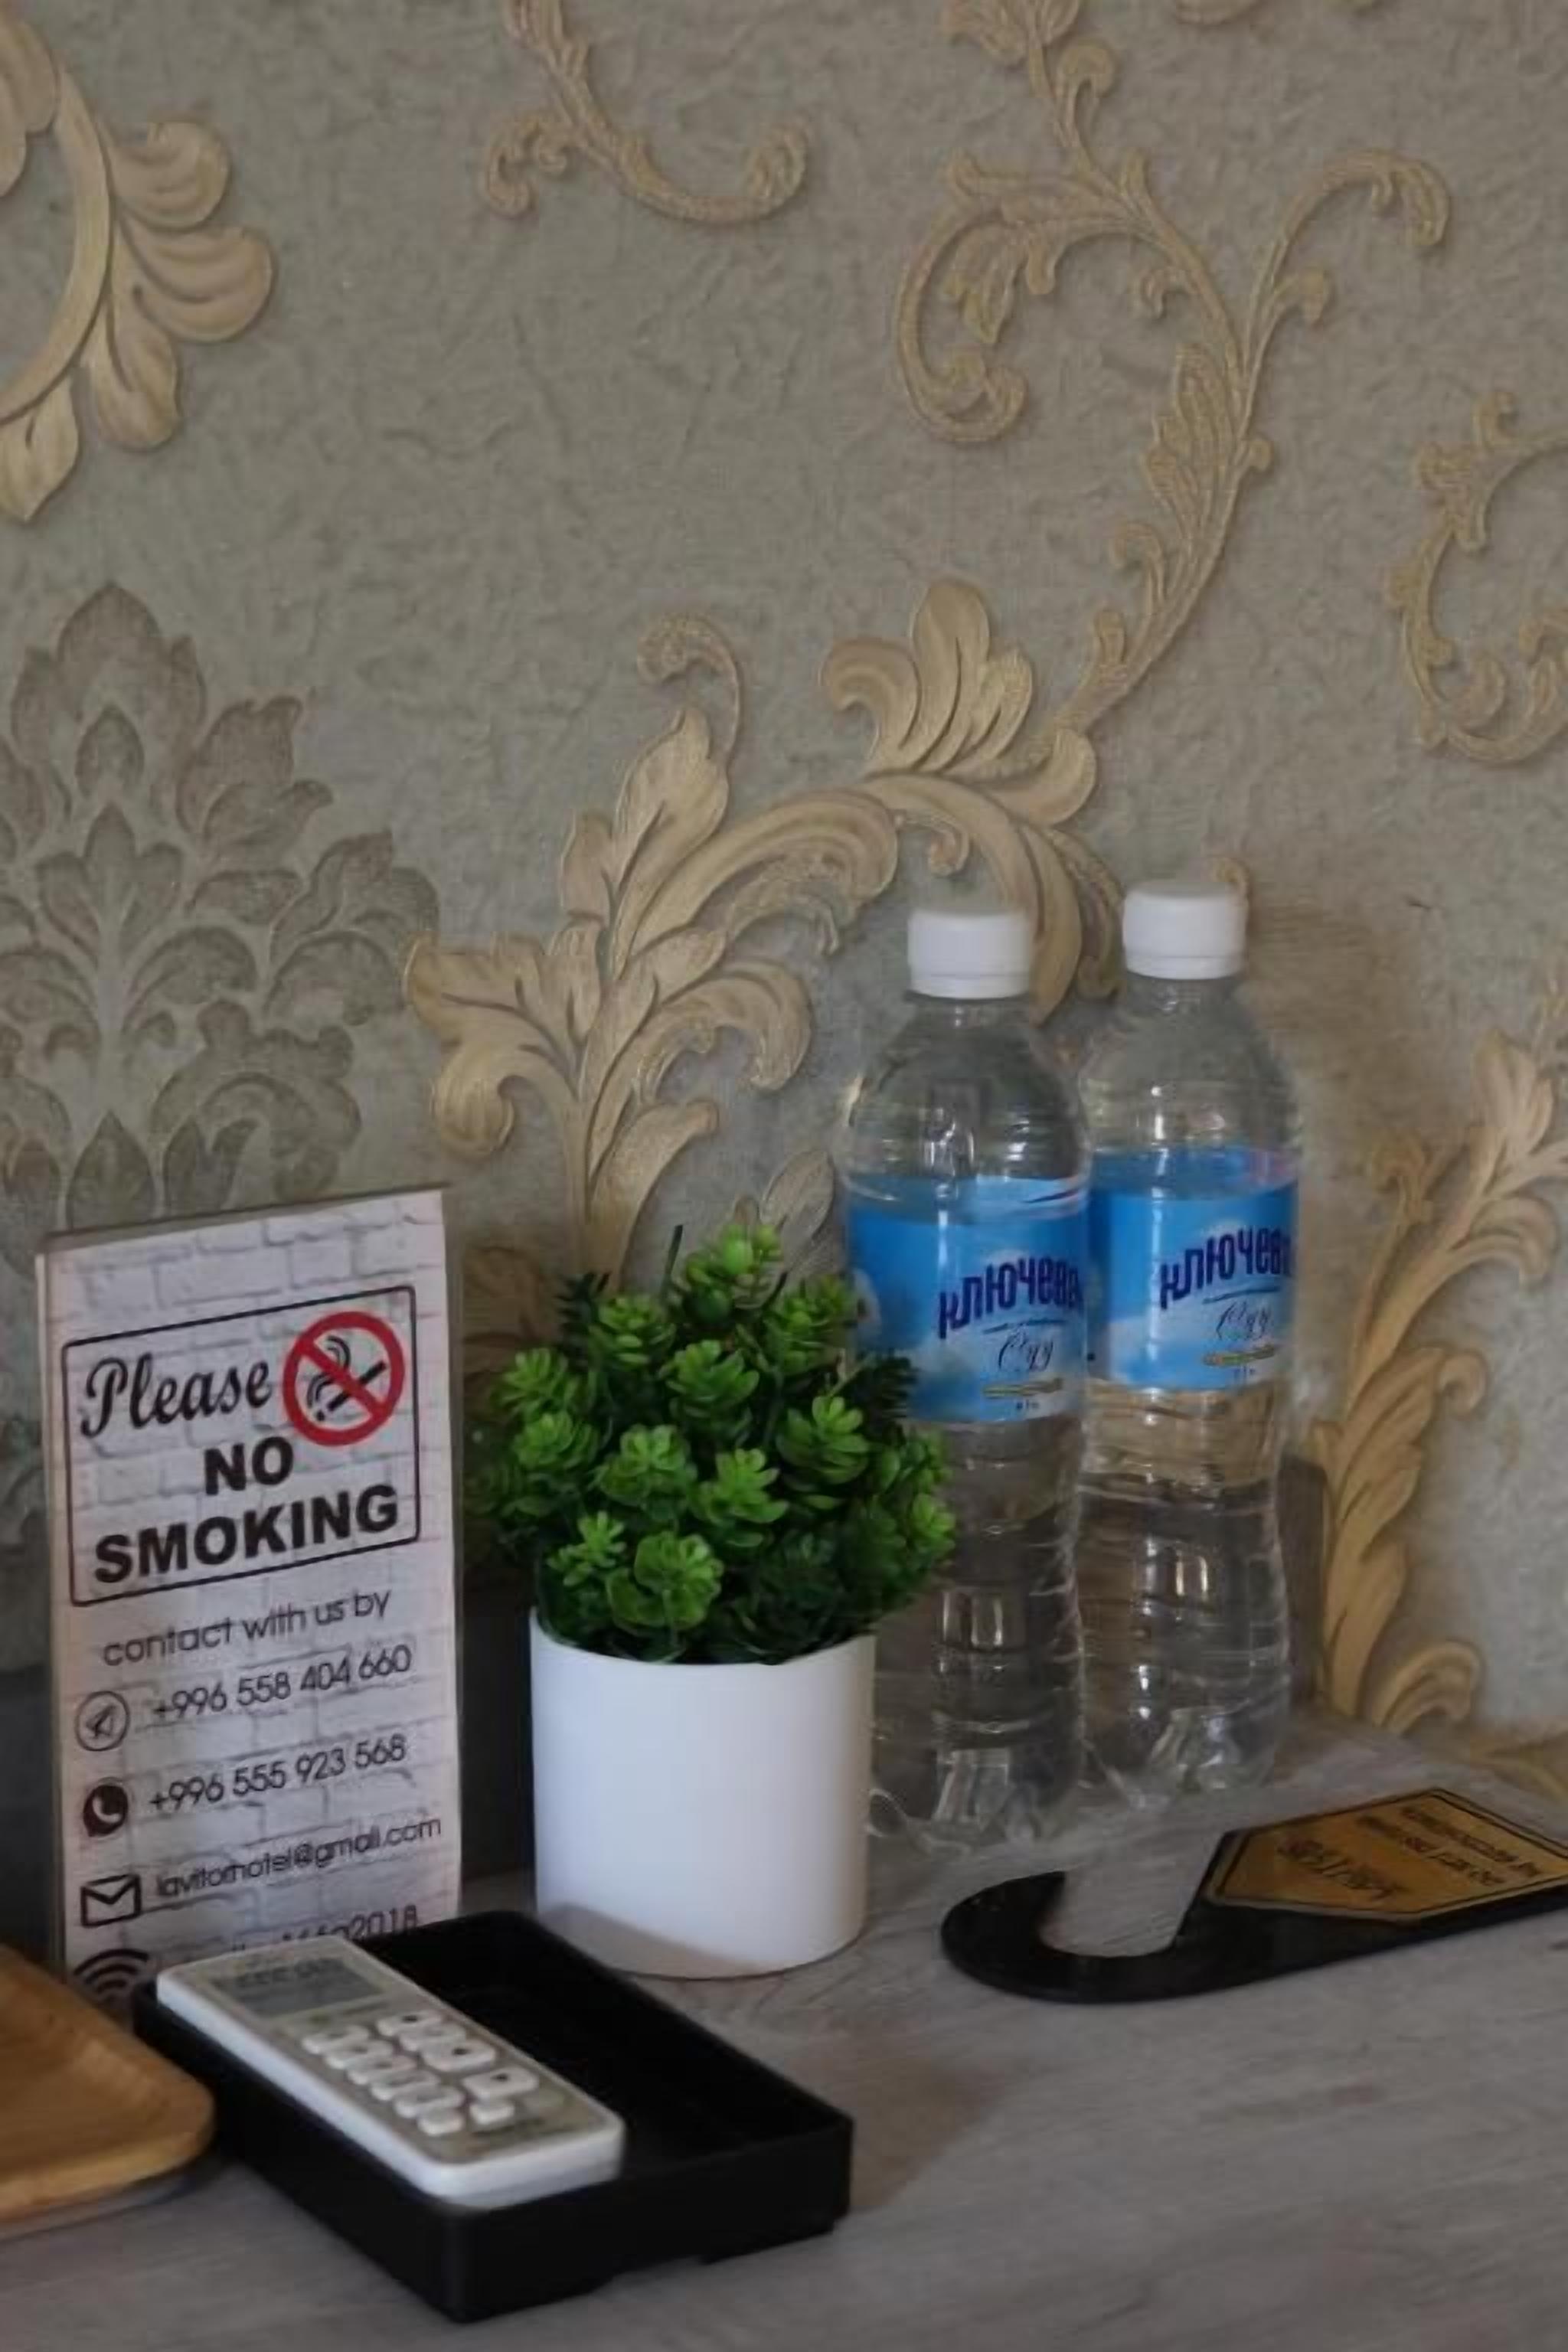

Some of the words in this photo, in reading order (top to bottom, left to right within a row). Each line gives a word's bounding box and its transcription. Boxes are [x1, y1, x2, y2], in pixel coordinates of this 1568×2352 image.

[81, 1353, 271, 1437] Please
[204, 1436, 295, 1495] NO
[93, 1484, 398, 1583] SMOKING
[102, 1617, 233, 1667] contact
[242, 1602, 306, 1639] with
[315, 1598, 345, 1625] us
[353, 1588, 392, 1622] by
[153, 1681, 227, 1718] +996
[237, 1672, 291, 1706] 558
[299, 1657, 351, 1690] 404
[358, 1644, 412, 1679] 660
[150, 1773, 224, 1811] +996
[233, 1760, 286, 1796] 555
[295, 1748, 347, 1783] 923
[354, 1733, 407, 1769] 568
